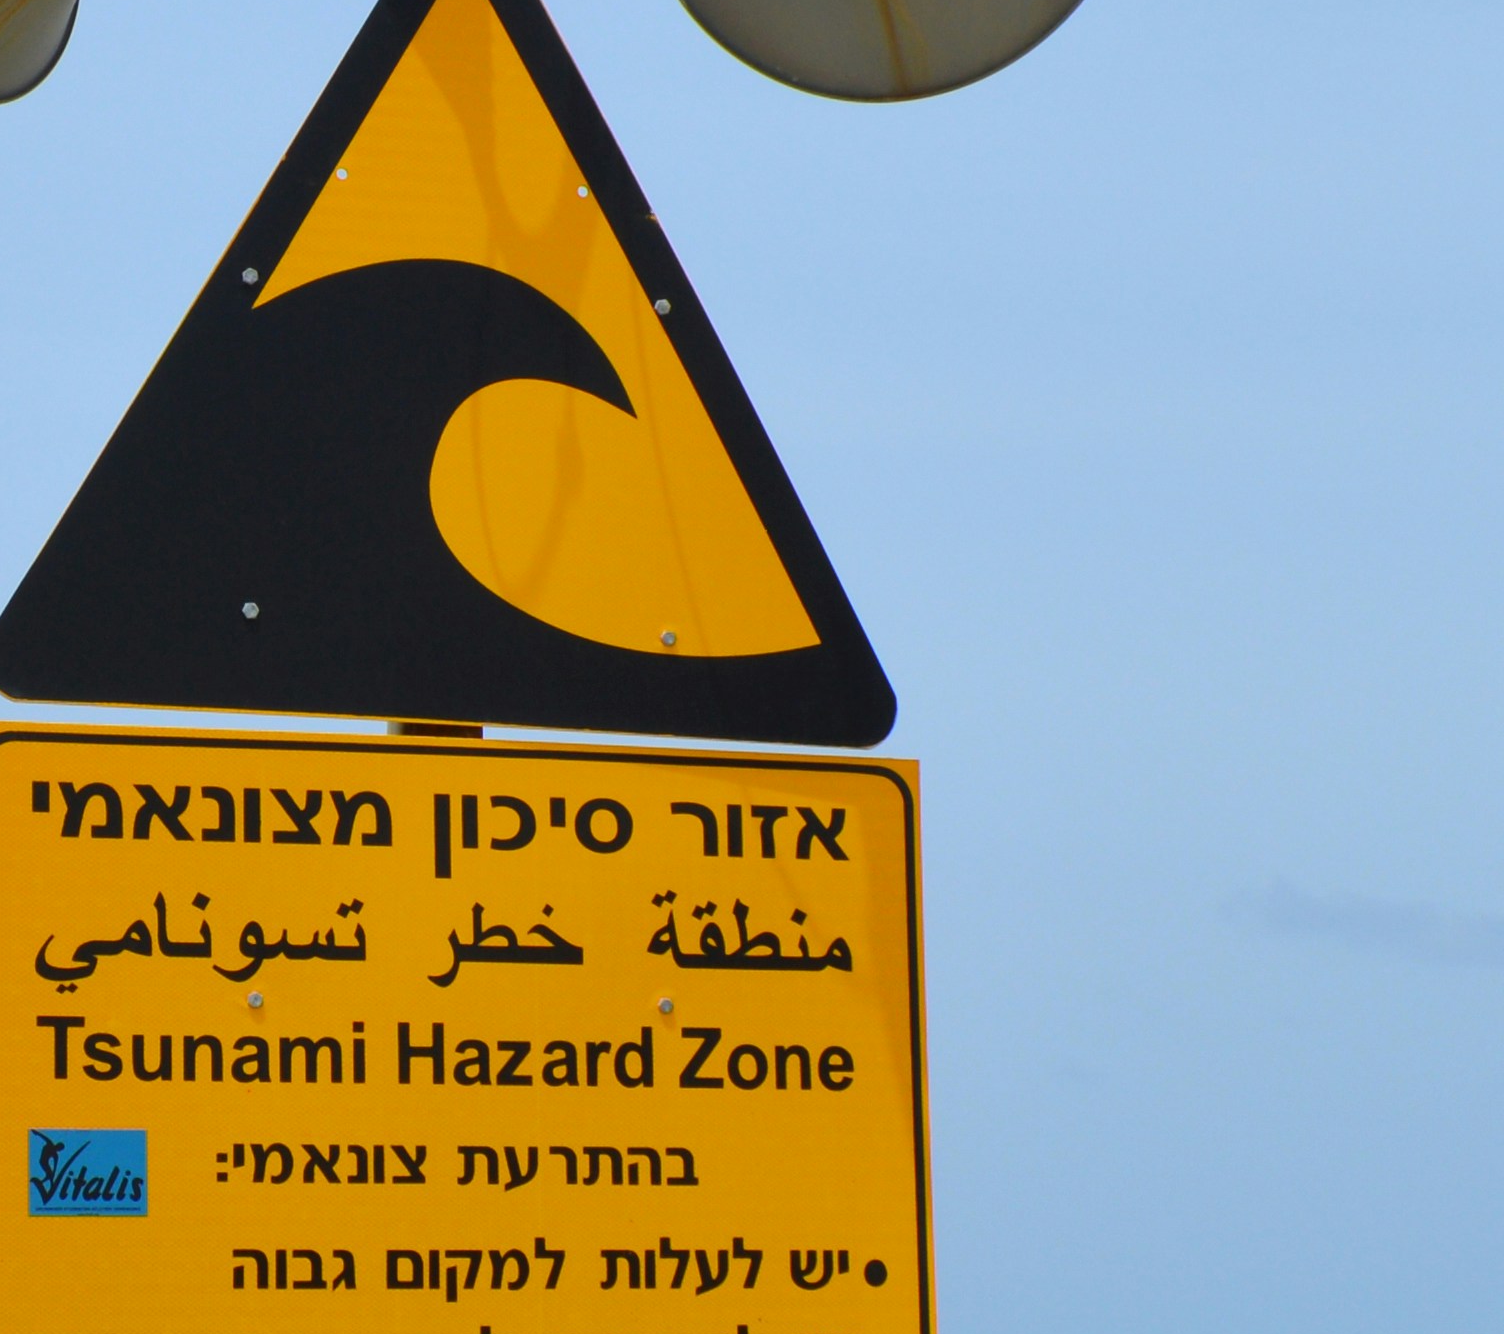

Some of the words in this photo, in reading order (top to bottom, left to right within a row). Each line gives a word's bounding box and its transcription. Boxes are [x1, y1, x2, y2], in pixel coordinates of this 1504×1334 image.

[32, 782, 392, 847] מצונאמי
[435, 795, 633, 879] סיכון
[672, 803, 849, 861] אזור
[35, 892, 366, 994] تسونامي
[429, 903, 584, 988] خطر
[648, 890, 853, 972] منطقة
[37, 1017, 366, 1084] Tsunami
[398, 1023, 654, 1088] Hazard
[679, 1028, 854, 1092] Zone
[29, 1139, 144, 1205] Vitalis
[216, 1143, 427, 1184] צונאמי:
[457, 1146, 699, 1191] בהתרעת
[232, 1249, 356, 1290] גבוה
[386, 1238, 566, 1303] למקום
[602, 1237, 763, 1294] לעלות
[791, 1250, 850, 1291] יש
